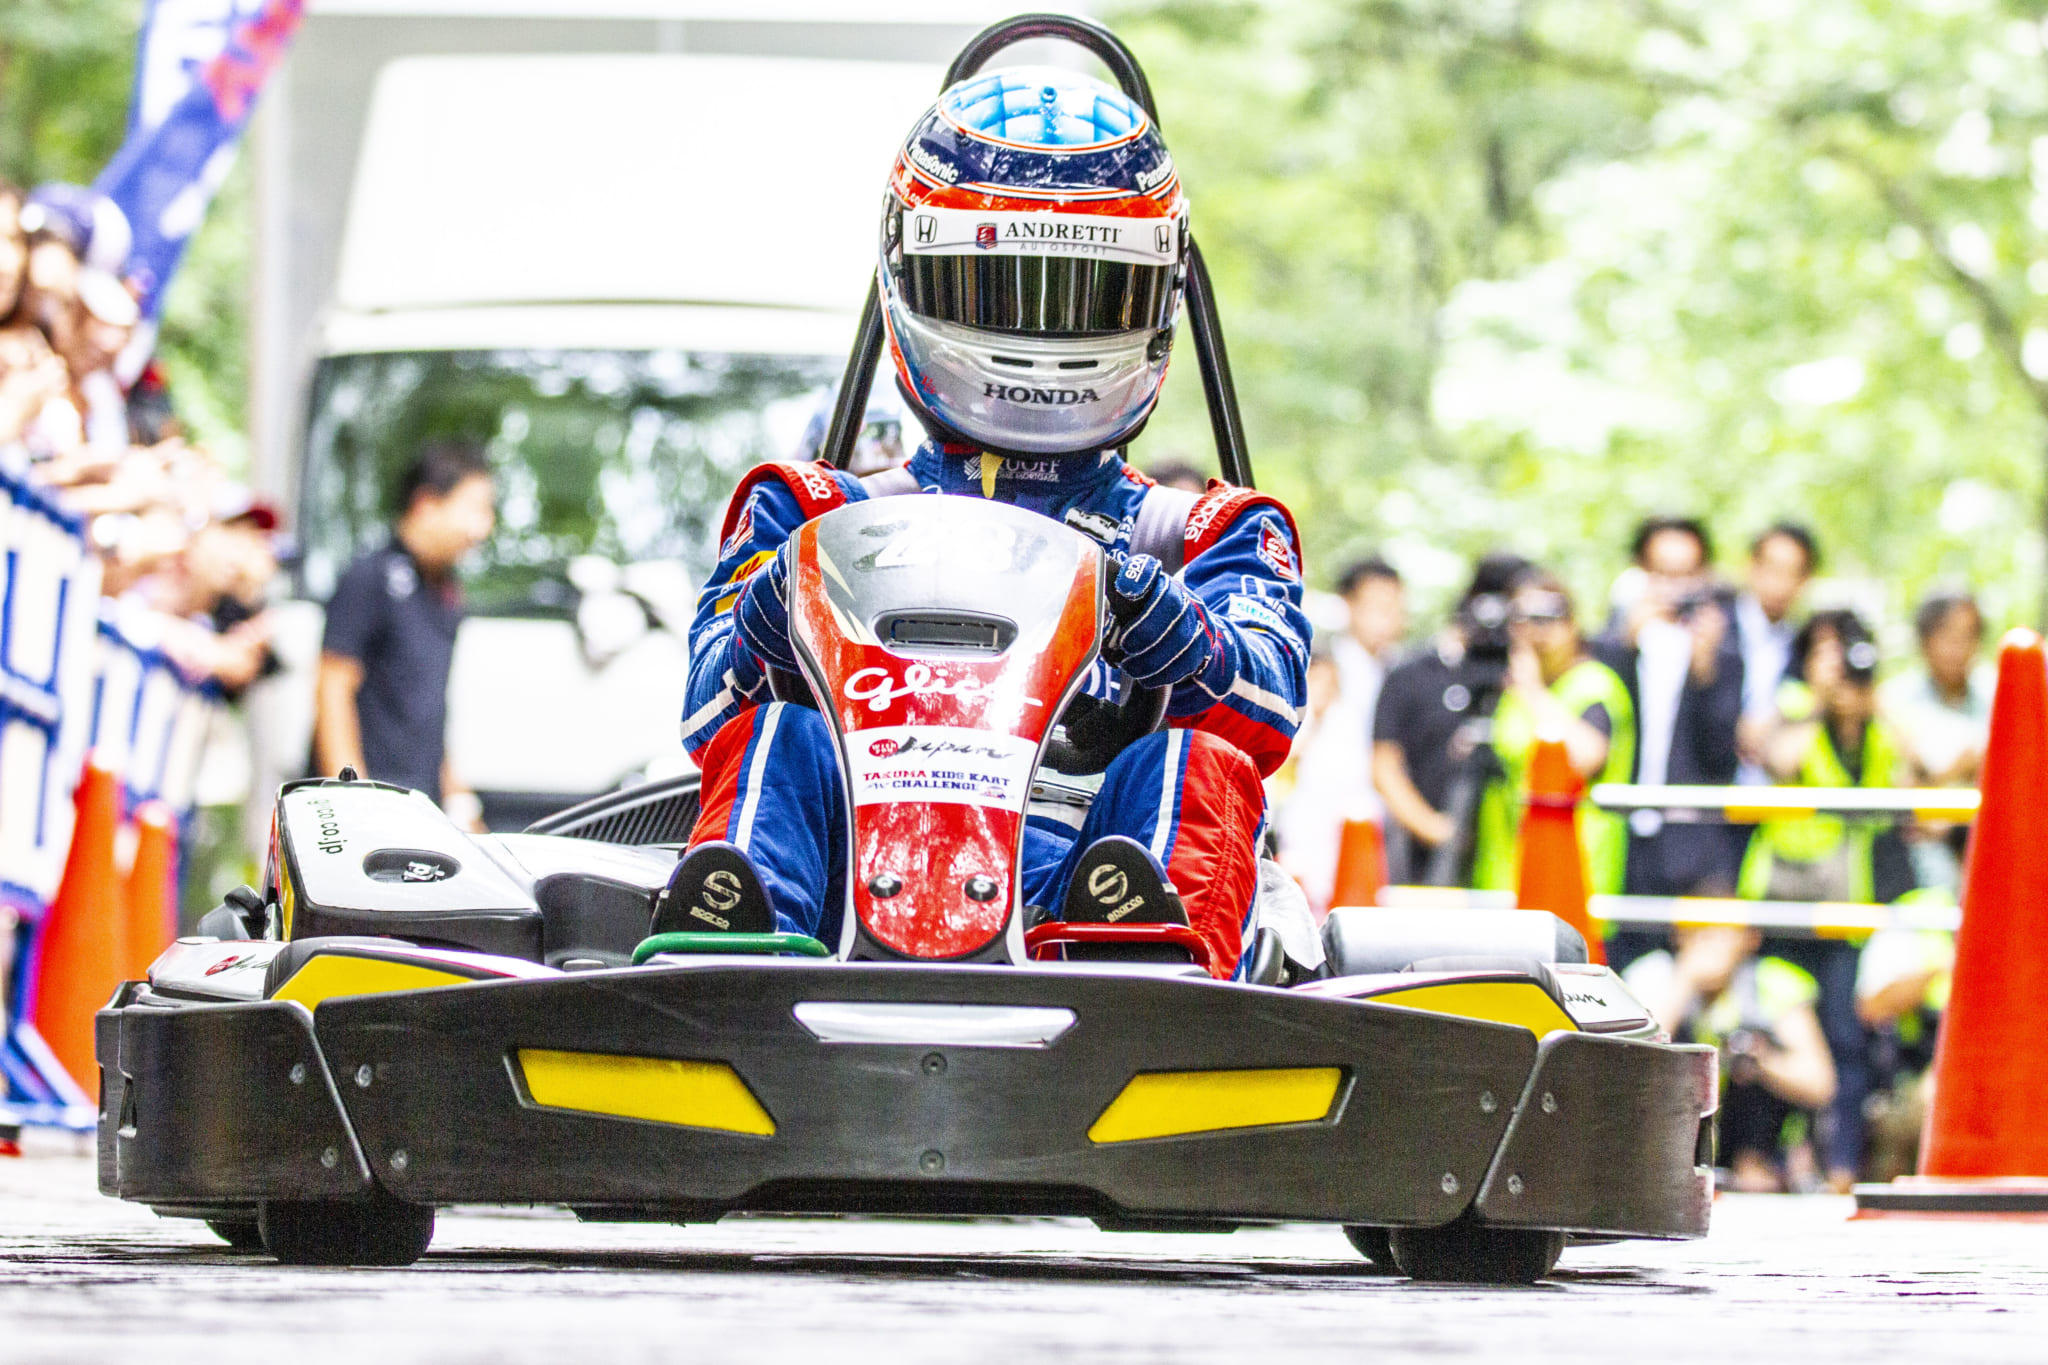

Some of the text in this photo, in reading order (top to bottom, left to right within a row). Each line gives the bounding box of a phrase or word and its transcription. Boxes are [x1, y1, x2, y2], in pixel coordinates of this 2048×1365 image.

[1005, 222, 1118, 243] ANDRETTI
[1020, 242, 1107, 255] AUTOSPORT
[983, 382, 1101, 405] HONDA
[1000, 457, 1061, 473] UOFF
[863, 770, 1011, 786] TAKUMA KIDS KART
[892, 780, 978, 791] CHALLENGE
[689, 906, 730, 930] sparco
[1107, 895, 1145, 923] sparco
